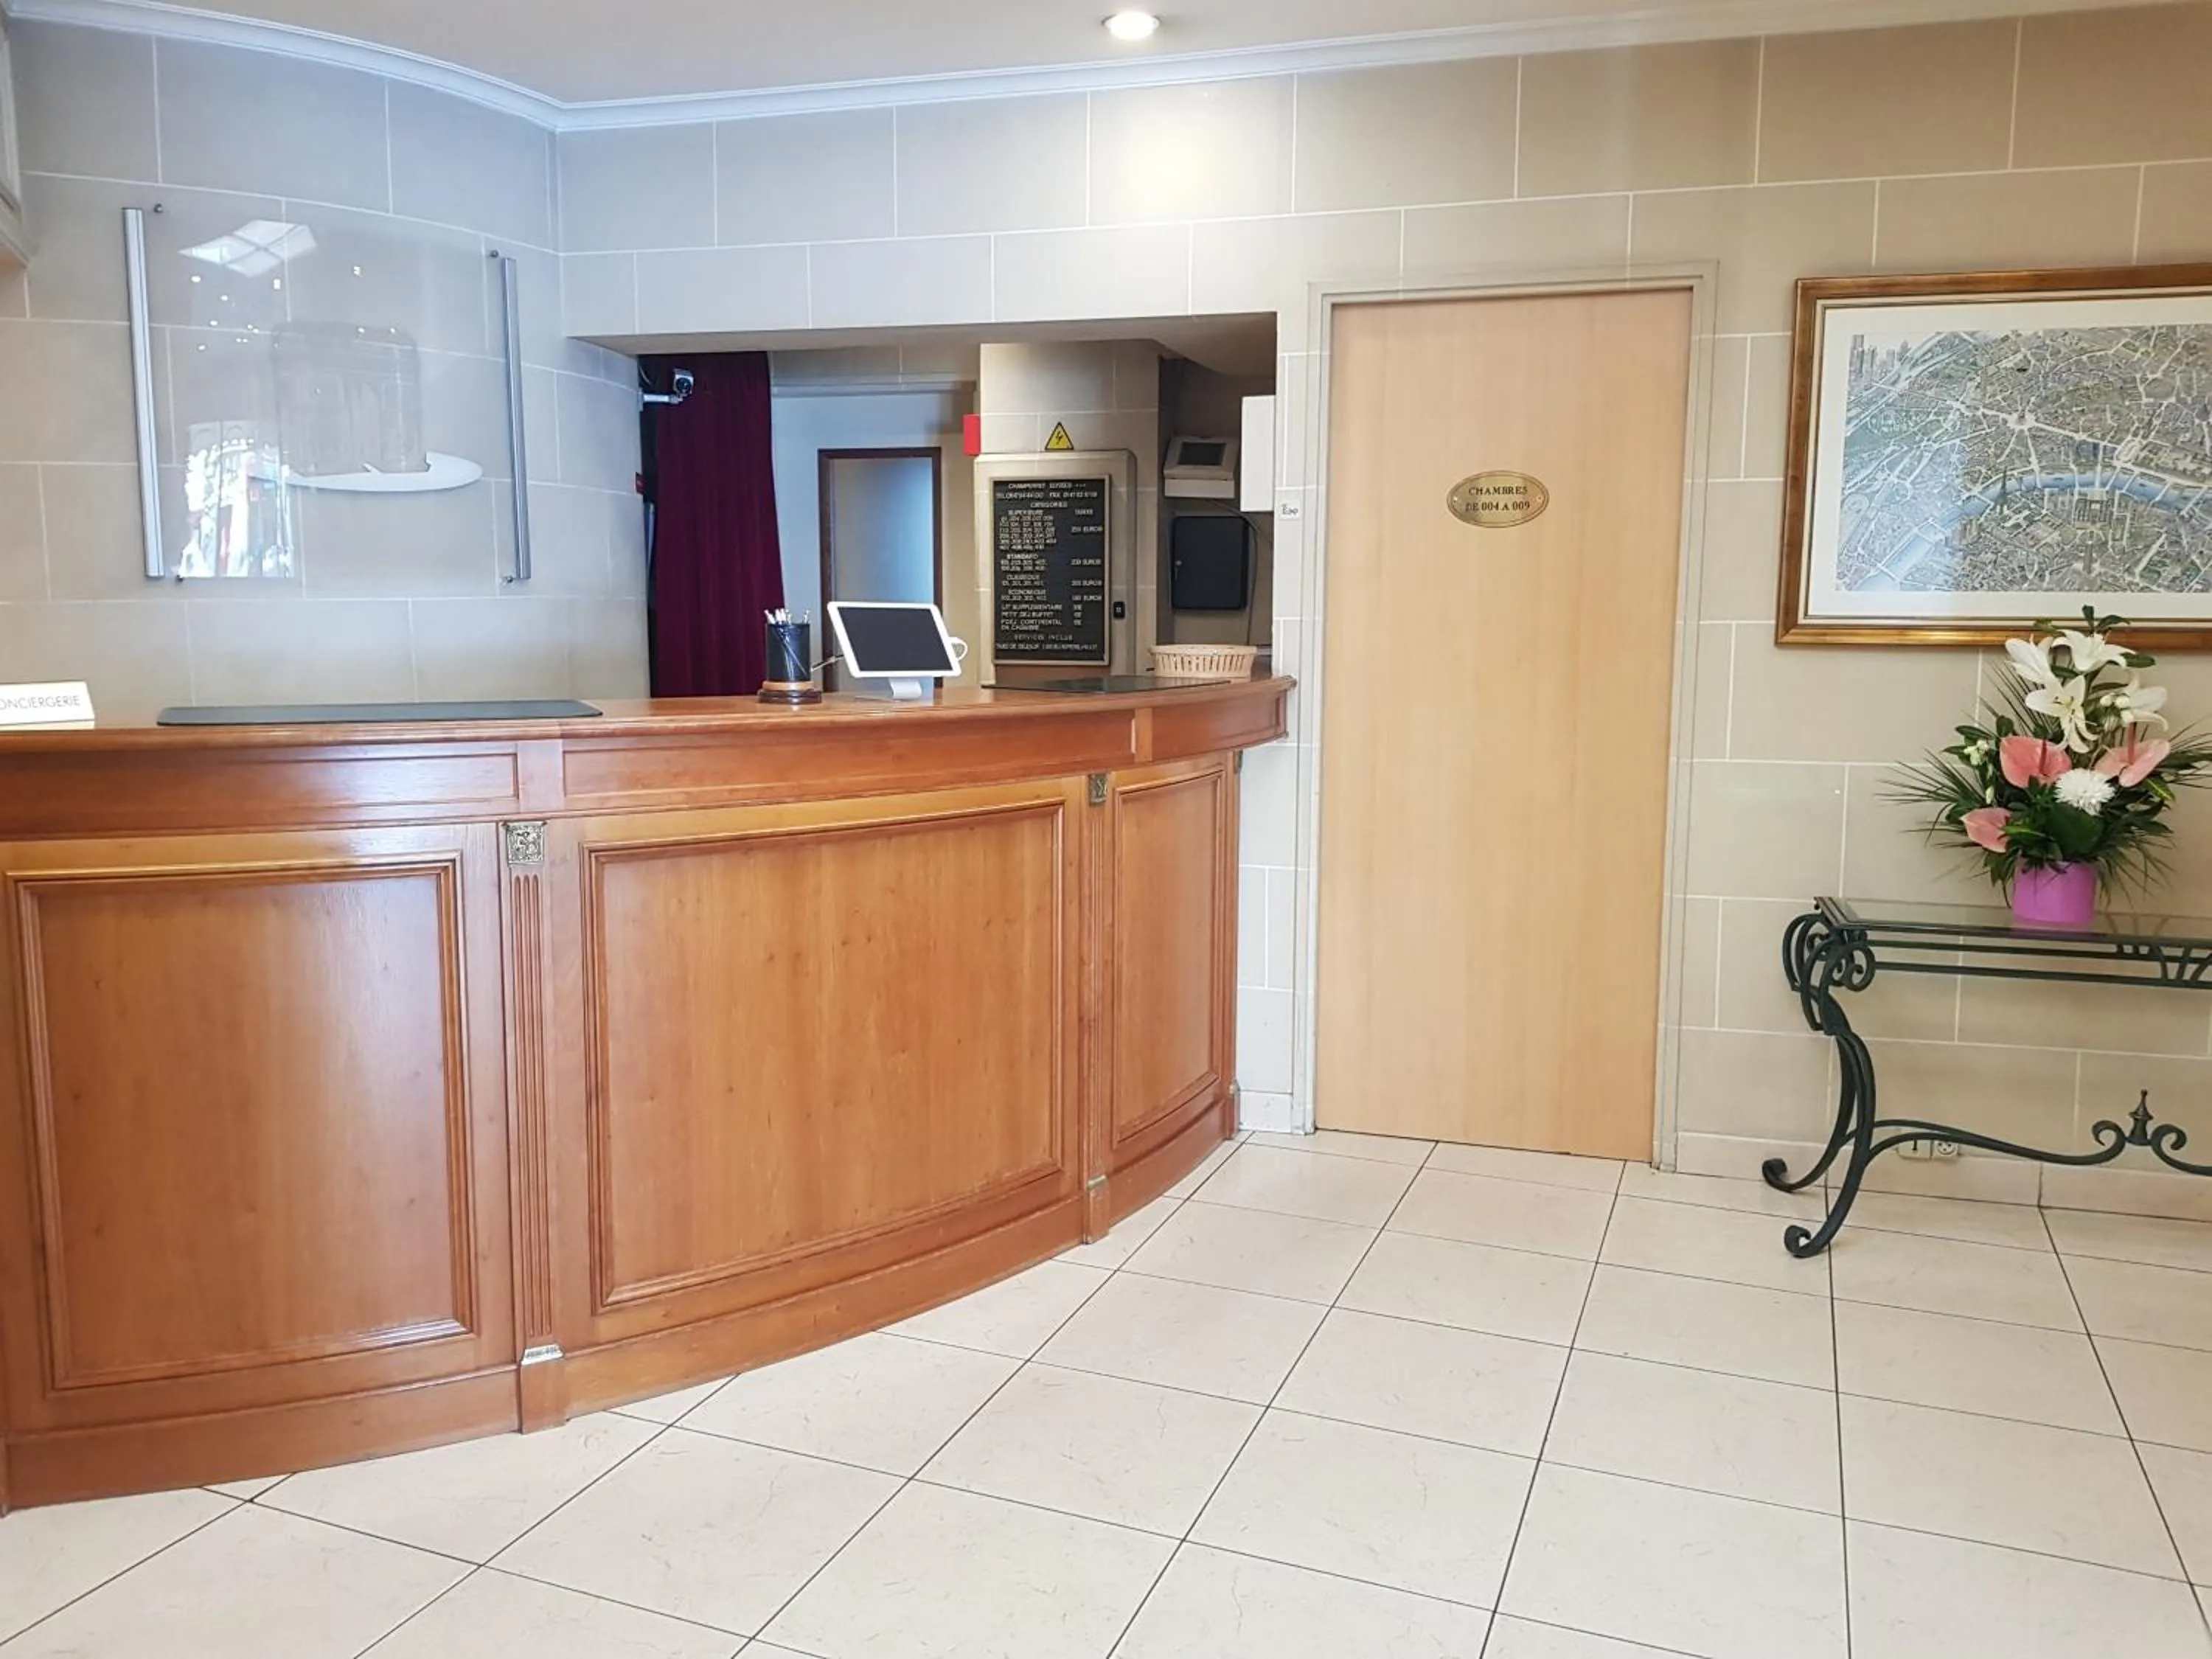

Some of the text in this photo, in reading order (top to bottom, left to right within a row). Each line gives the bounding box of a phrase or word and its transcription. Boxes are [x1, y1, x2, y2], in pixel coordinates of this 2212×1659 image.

[1468, 486, 1528, 495] CHAMBRES
[1465, 501, 1530, 512] DE 004 A 009
[0, 695, 81, 710] ONCIERGERIE
